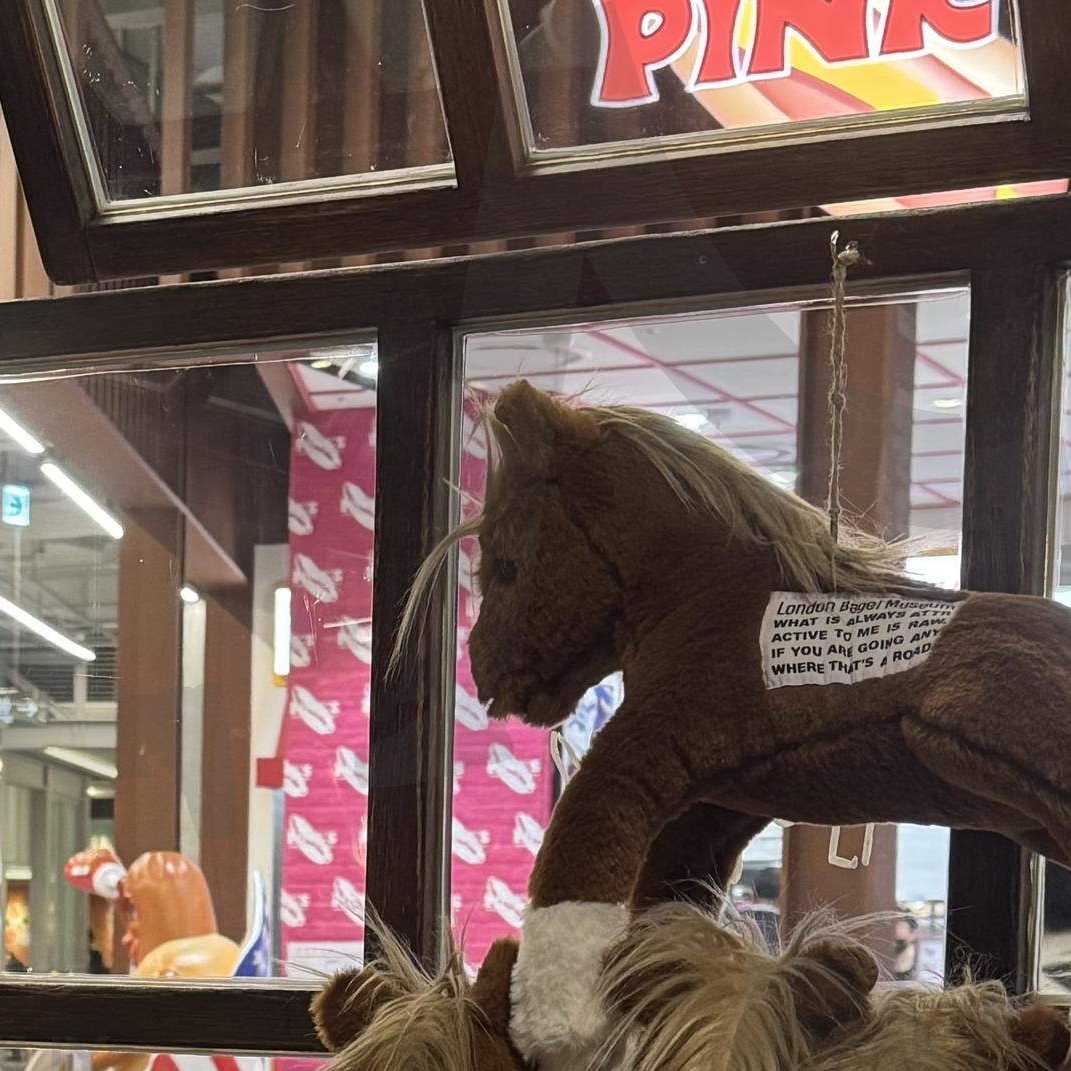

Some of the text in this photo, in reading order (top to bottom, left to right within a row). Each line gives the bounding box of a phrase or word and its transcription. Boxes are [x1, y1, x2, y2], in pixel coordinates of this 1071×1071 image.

[777, 599, 955, 616] London Bagel Museum
[773, 616, 819, 629] WHAT
[826, 615, 840, 625] IS
[846, 611, 906, 627] ALWAYS
[771, 630, 828, 643] ACTIVE
[834, 629, 852, 642] TO
[857, 625, 880, 638] ME
[886, 621, 901, 633] IS
[771, 628, 940, 659] IF YOU ARE GOING ANY
[771, 642, 931, 676] WHERE THAT'S A ROAD
